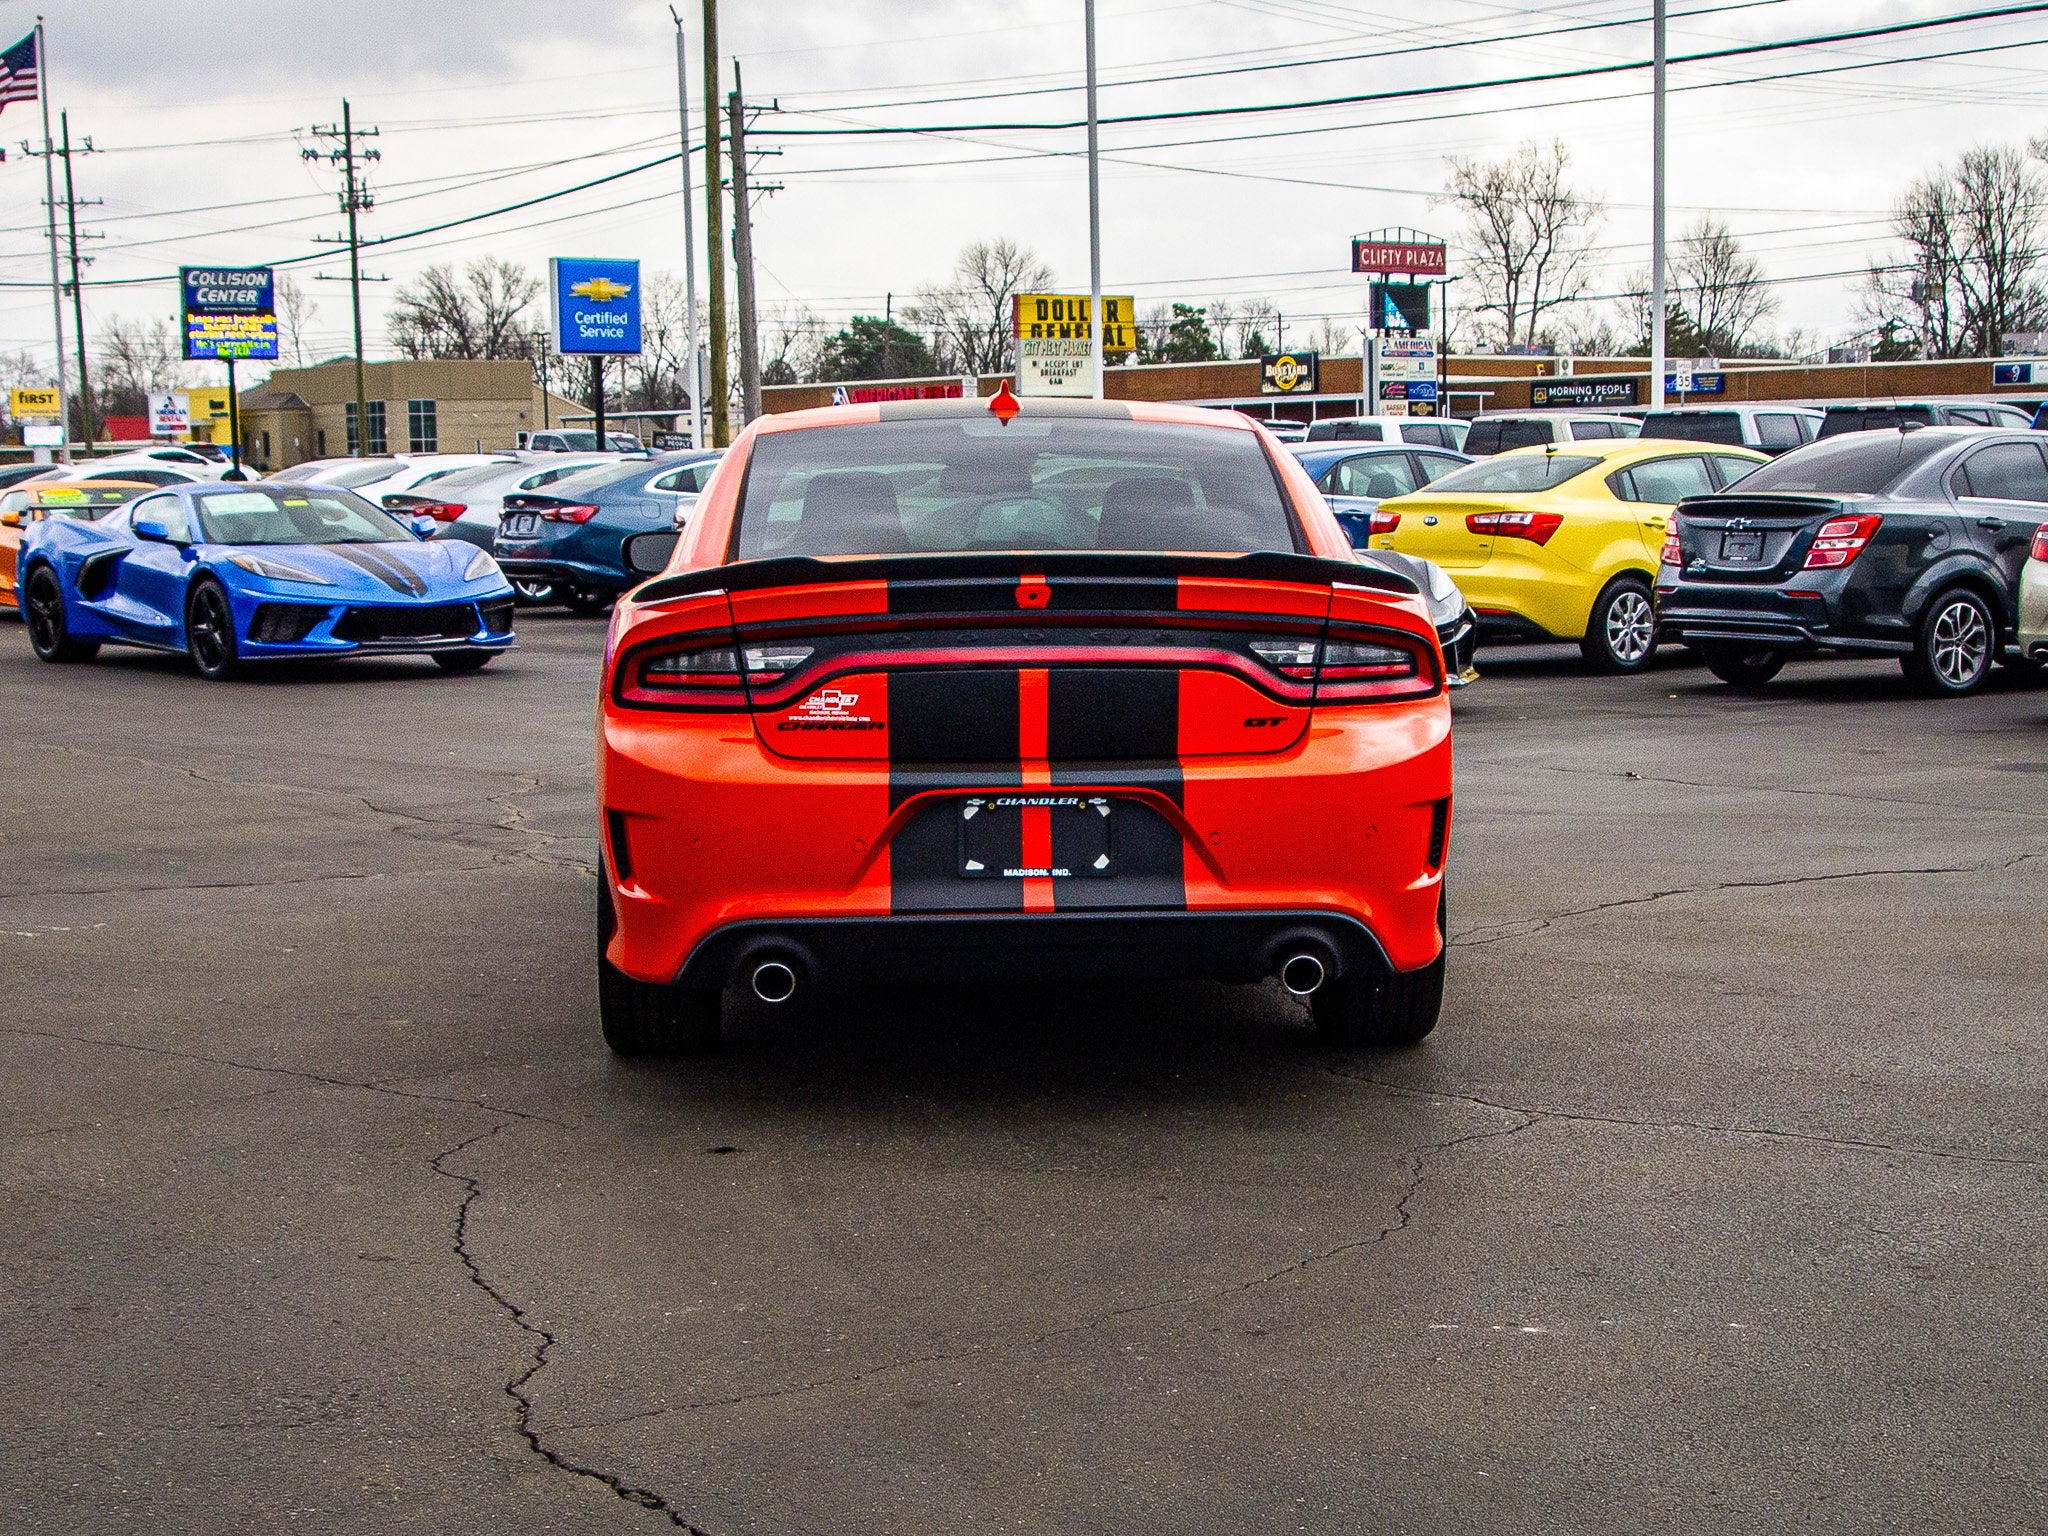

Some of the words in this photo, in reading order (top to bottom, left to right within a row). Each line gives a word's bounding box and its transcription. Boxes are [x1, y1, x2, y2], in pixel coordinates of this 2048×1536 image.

[1361, 248, 1401, 264] CLIFTY
[1406, 250, 1444, 266] PLAZA
[187, 270, 268, 287] COLLISION
[197, 287, 258, 303] CENTER
[1036, 298, 1120, 323] DOLLR
[574, 311, 629, 325] Certified
[579, 324, 624, 338] Service
[1031, 323, 1126, 347] GENEAL
[1394, 341, 1433, 350] AMERICAN
[1040, 368, 1077, 376] BREAKFAST
[1678, 375, 1690, 387] 35
[851, 387, 915, 404] AMERICAN
[1549, 386, 1591, 396] MORNING
[1596, 384, 1631, 394] PEOPLE
[1576, 395, 1603, 403] CAFE
[809, 696, 852, 704] CHANDLER
[1244, 716, 1288, 727] GT
[996, 798, 1079, 806] CHANDLER
[1052, 868, 1072, 877] IND.
